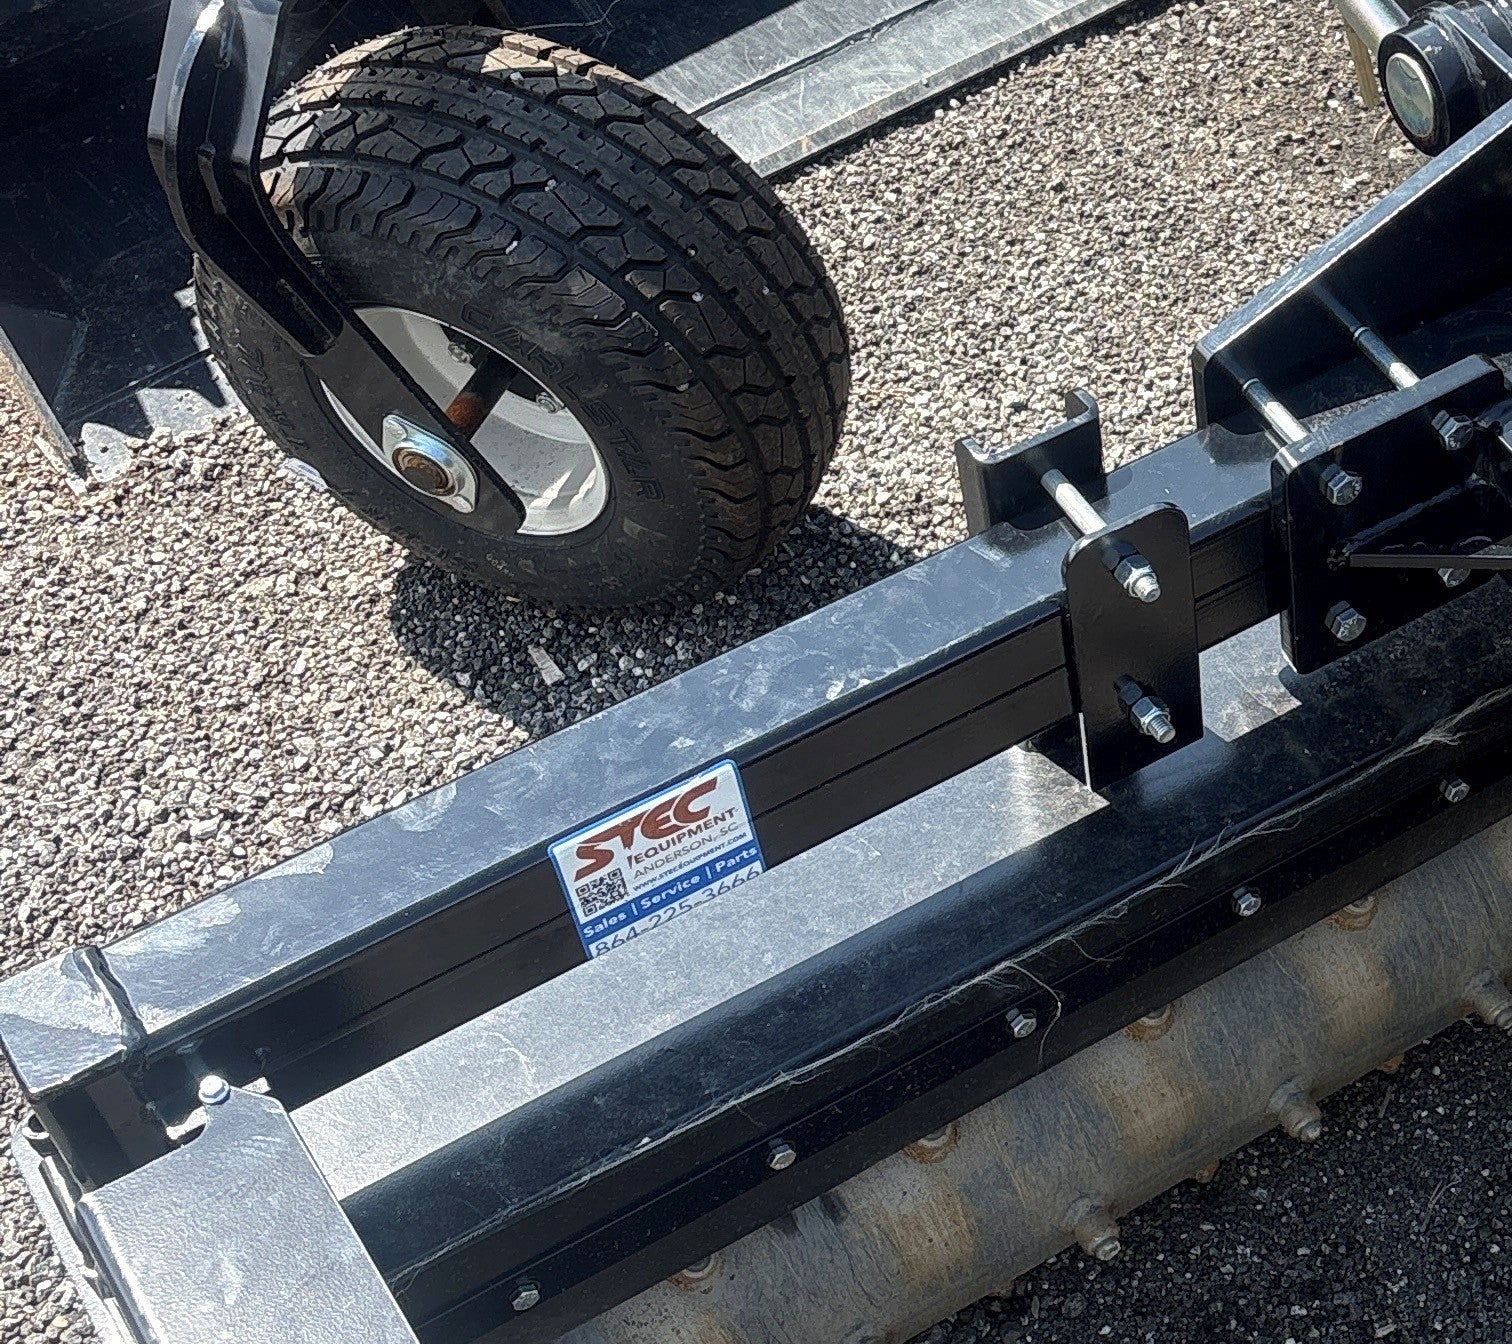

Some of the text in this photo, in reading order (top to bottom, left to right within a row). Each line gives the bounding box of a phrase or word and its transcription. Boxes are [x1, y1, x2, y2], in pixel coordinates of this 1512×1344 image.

[574, 776, 718, 883] STEC
[633, 806, 737, 865] EQUIPMENT
[719, 821, 740, 838] SC
[582, 912, 628, 939] Sales
[639, 873, 702, 911] Service
[714, 845, 759, 874] Parts
